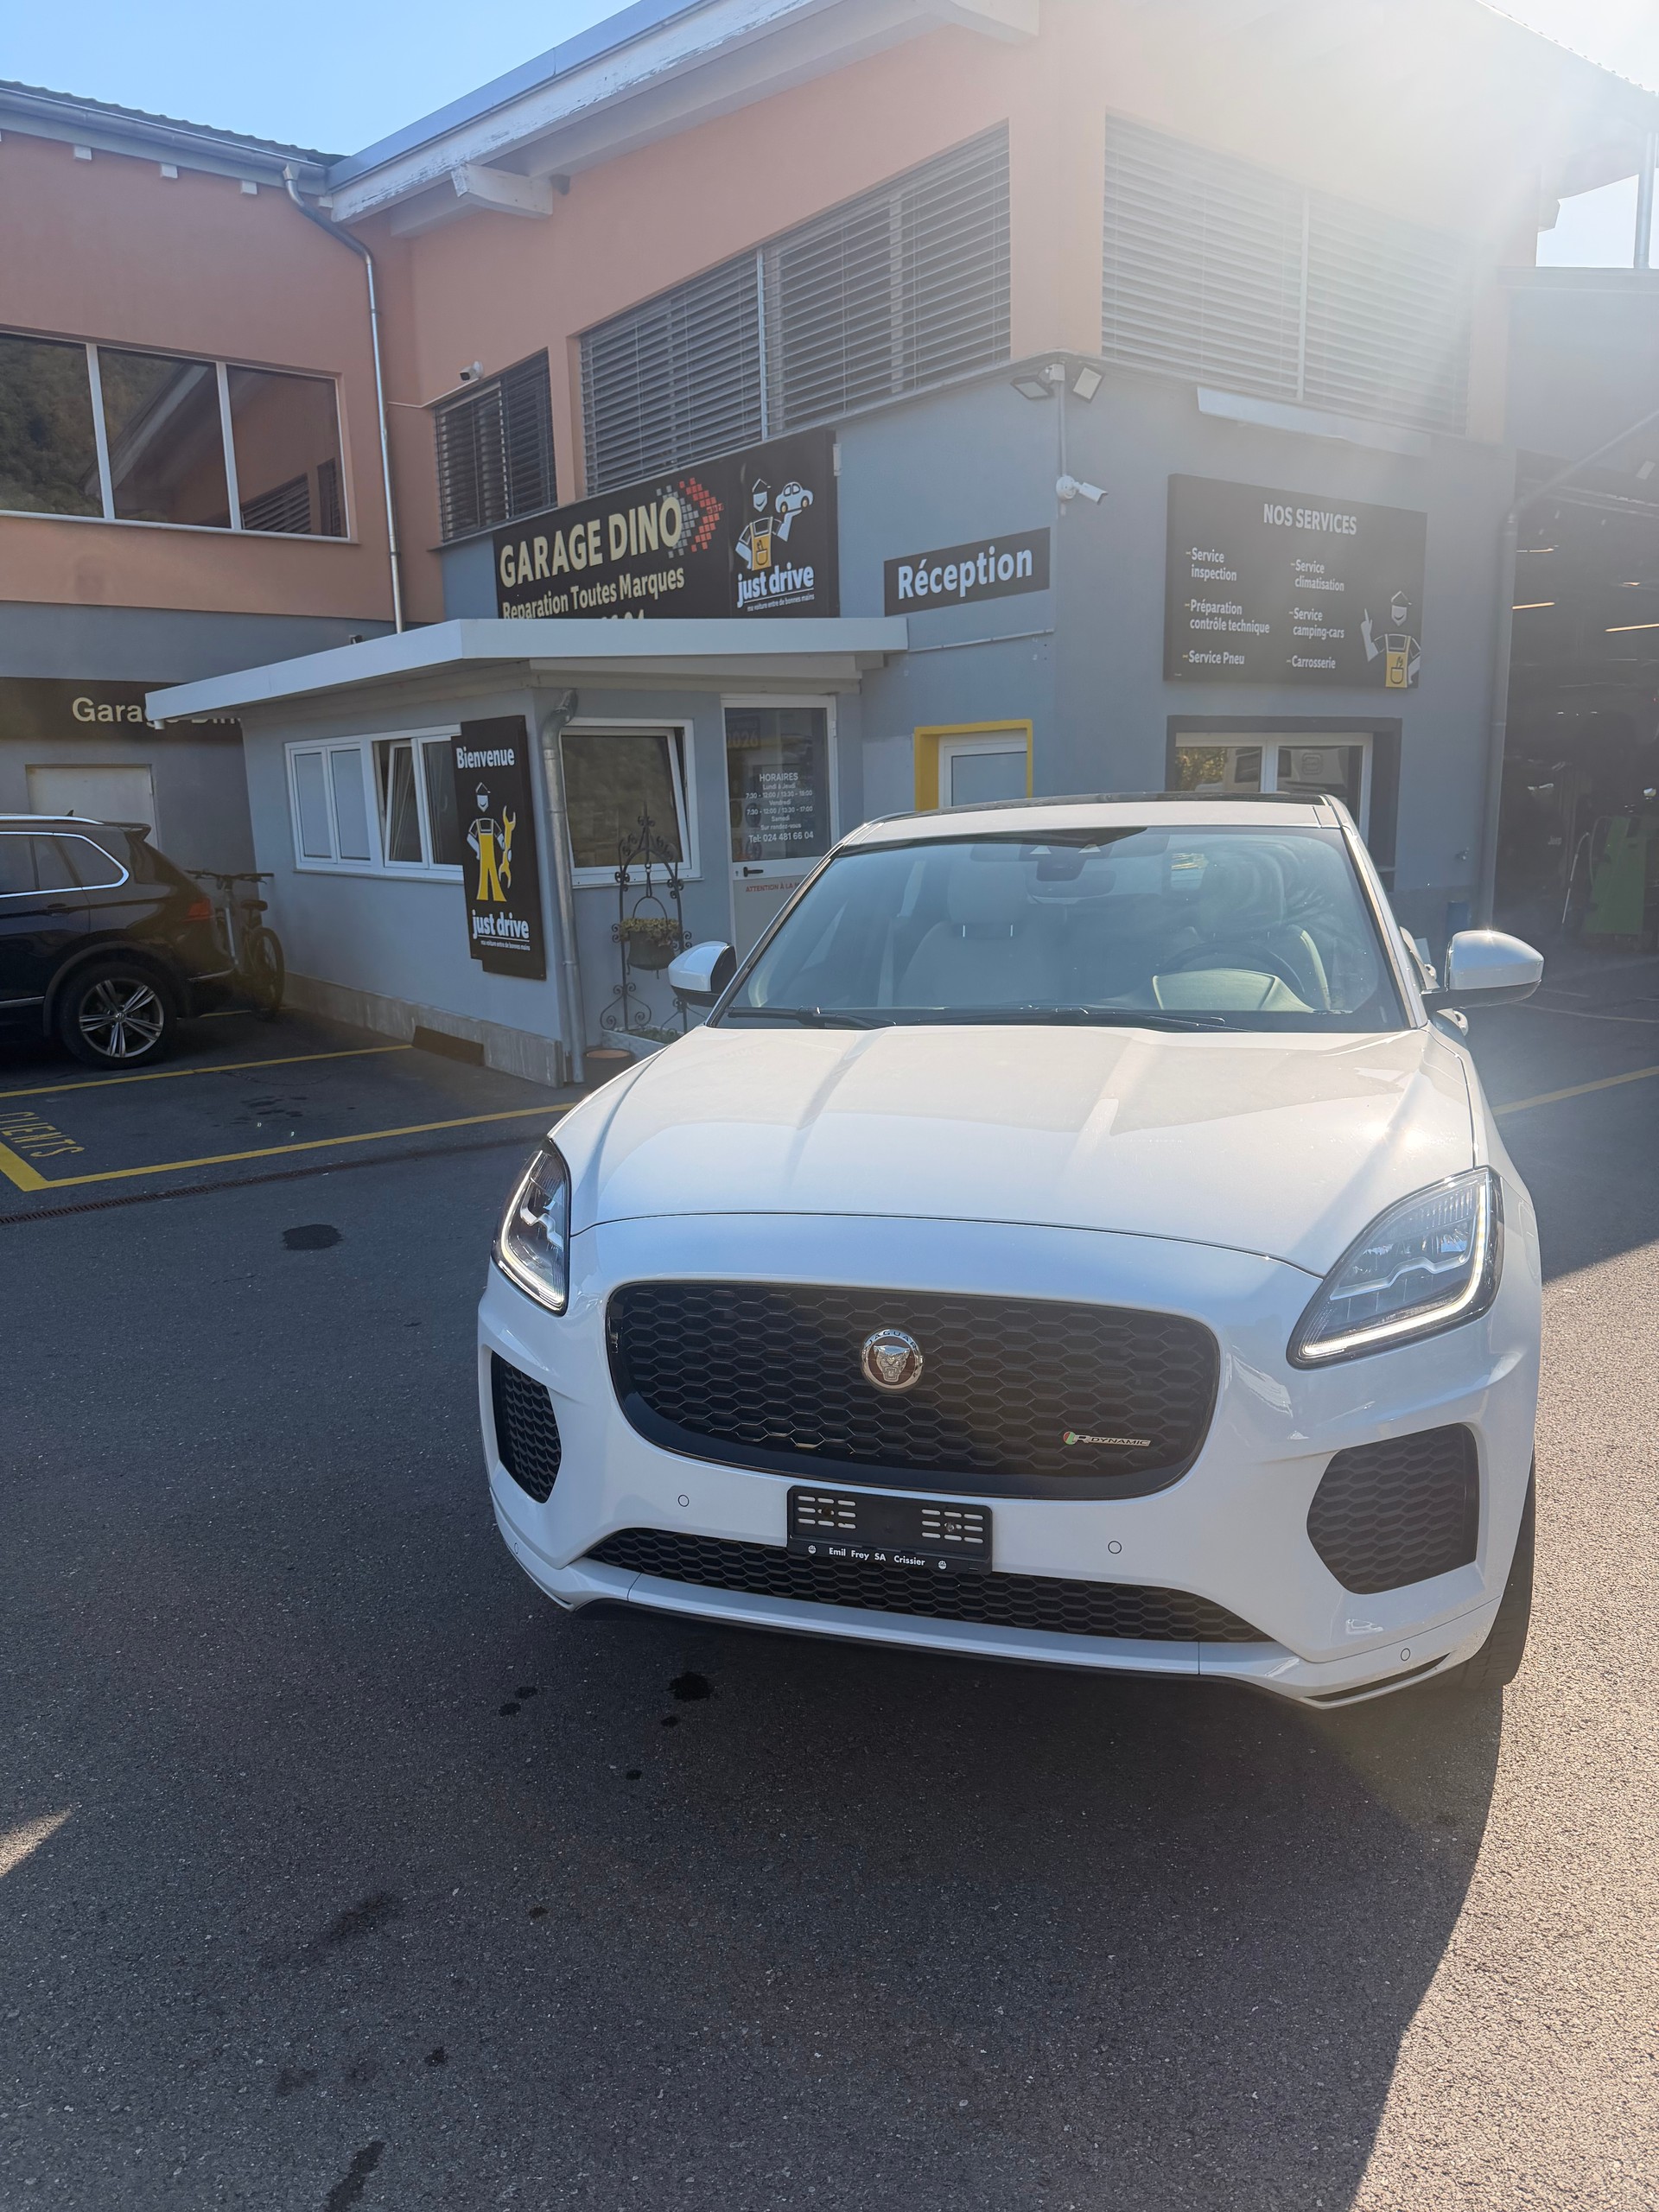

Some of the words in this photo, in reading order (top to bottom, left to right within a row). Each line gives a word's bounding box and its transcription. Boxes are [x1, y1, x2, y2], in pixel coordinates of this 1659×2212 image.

[1263, 503, 1293, 527] NOS
[1295, 508, 1357, 536] SERVICES
[500, 519, 603, 588] GARAGE
[608, 497, 683, 562] DINO
[1191, 547, 1224, 563] Service
[898, 545, 1033, 600] Réception
[1191, 564, 1237, 582] inspection
[1295, 559, 1325, 575] Service
[570, 582, 618, 610] Toutes
[619, 567, 685, 601] Marques
[737, 571, 767, 608] just
[768, 562, 814, 594] drive
[1294, 575, 1344, 592] climatisation
[1190, 598, 1243, 615] Préparation
[1294, 607, 1323, 621] Service
[1190, 617, 1227, 631] contrôle
[1228, 620, 1270, 636] technique
[1293, 625, 1344, 640] camping-cars
[1188, 650, 1221, 664] Service
[1223, 652, 1245, 664] Pneu
[1292, 655, 1336, 669] Carrosserie
[456, 746, 516, 770] Bienvenue
[759, 772, 799, 782] HORAIRES
[762, 833, 777, 842] 024
[779, 832, 791, 841] 481
[746, 884, 779, 893] ATTENTION
[472, 909, 496, 939] just
[496, 912, 530, 938] drive
[865, 1330, 918, 1351] JAGUAR
[829, 1547, 846, 1556] Emil
[851, 1549, 869, 1561] Frey
[874, 1552, 887, 1561] SA
[893, 1555, 925, 1567] Crissier
